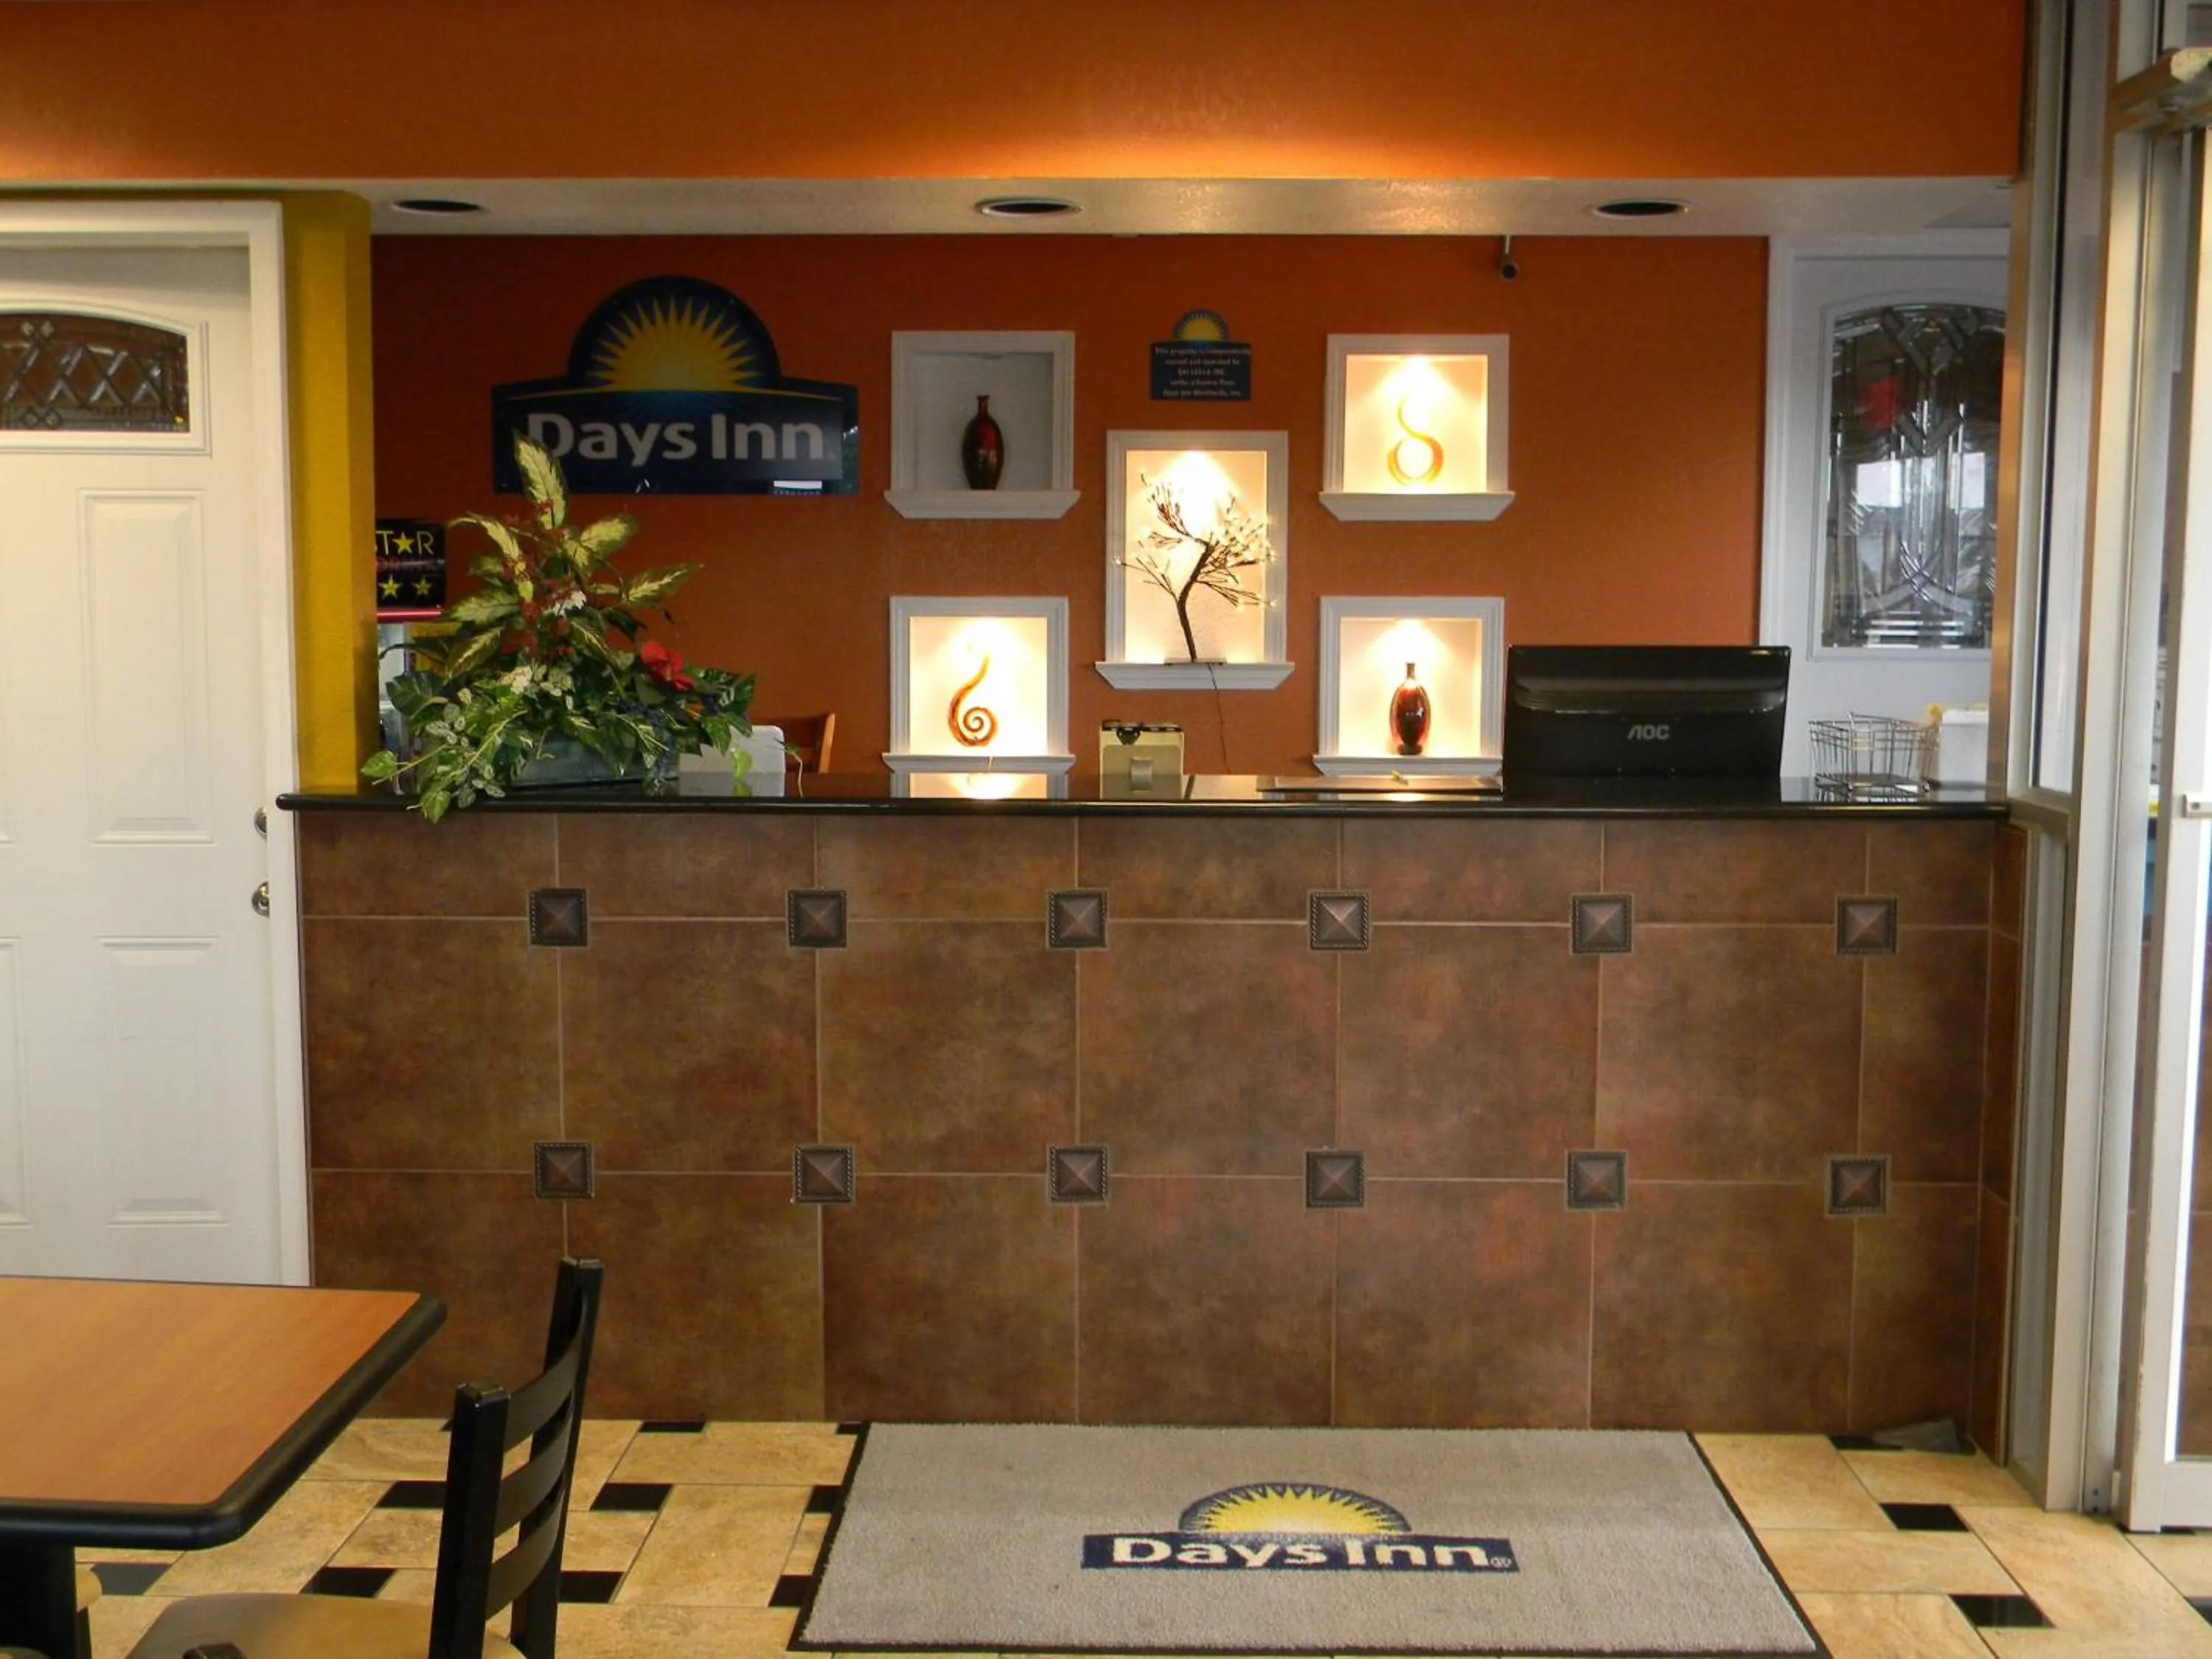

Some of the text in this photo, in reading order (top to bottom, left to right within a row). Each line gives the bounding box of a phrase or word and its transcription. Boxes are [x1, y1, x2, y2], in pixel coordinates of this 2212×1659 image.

[527, 414, 825, 467] Days Inn
[1627, 724, 1670, 740] AOC
[1111, 1537, 1489, 1568] Days Inn
